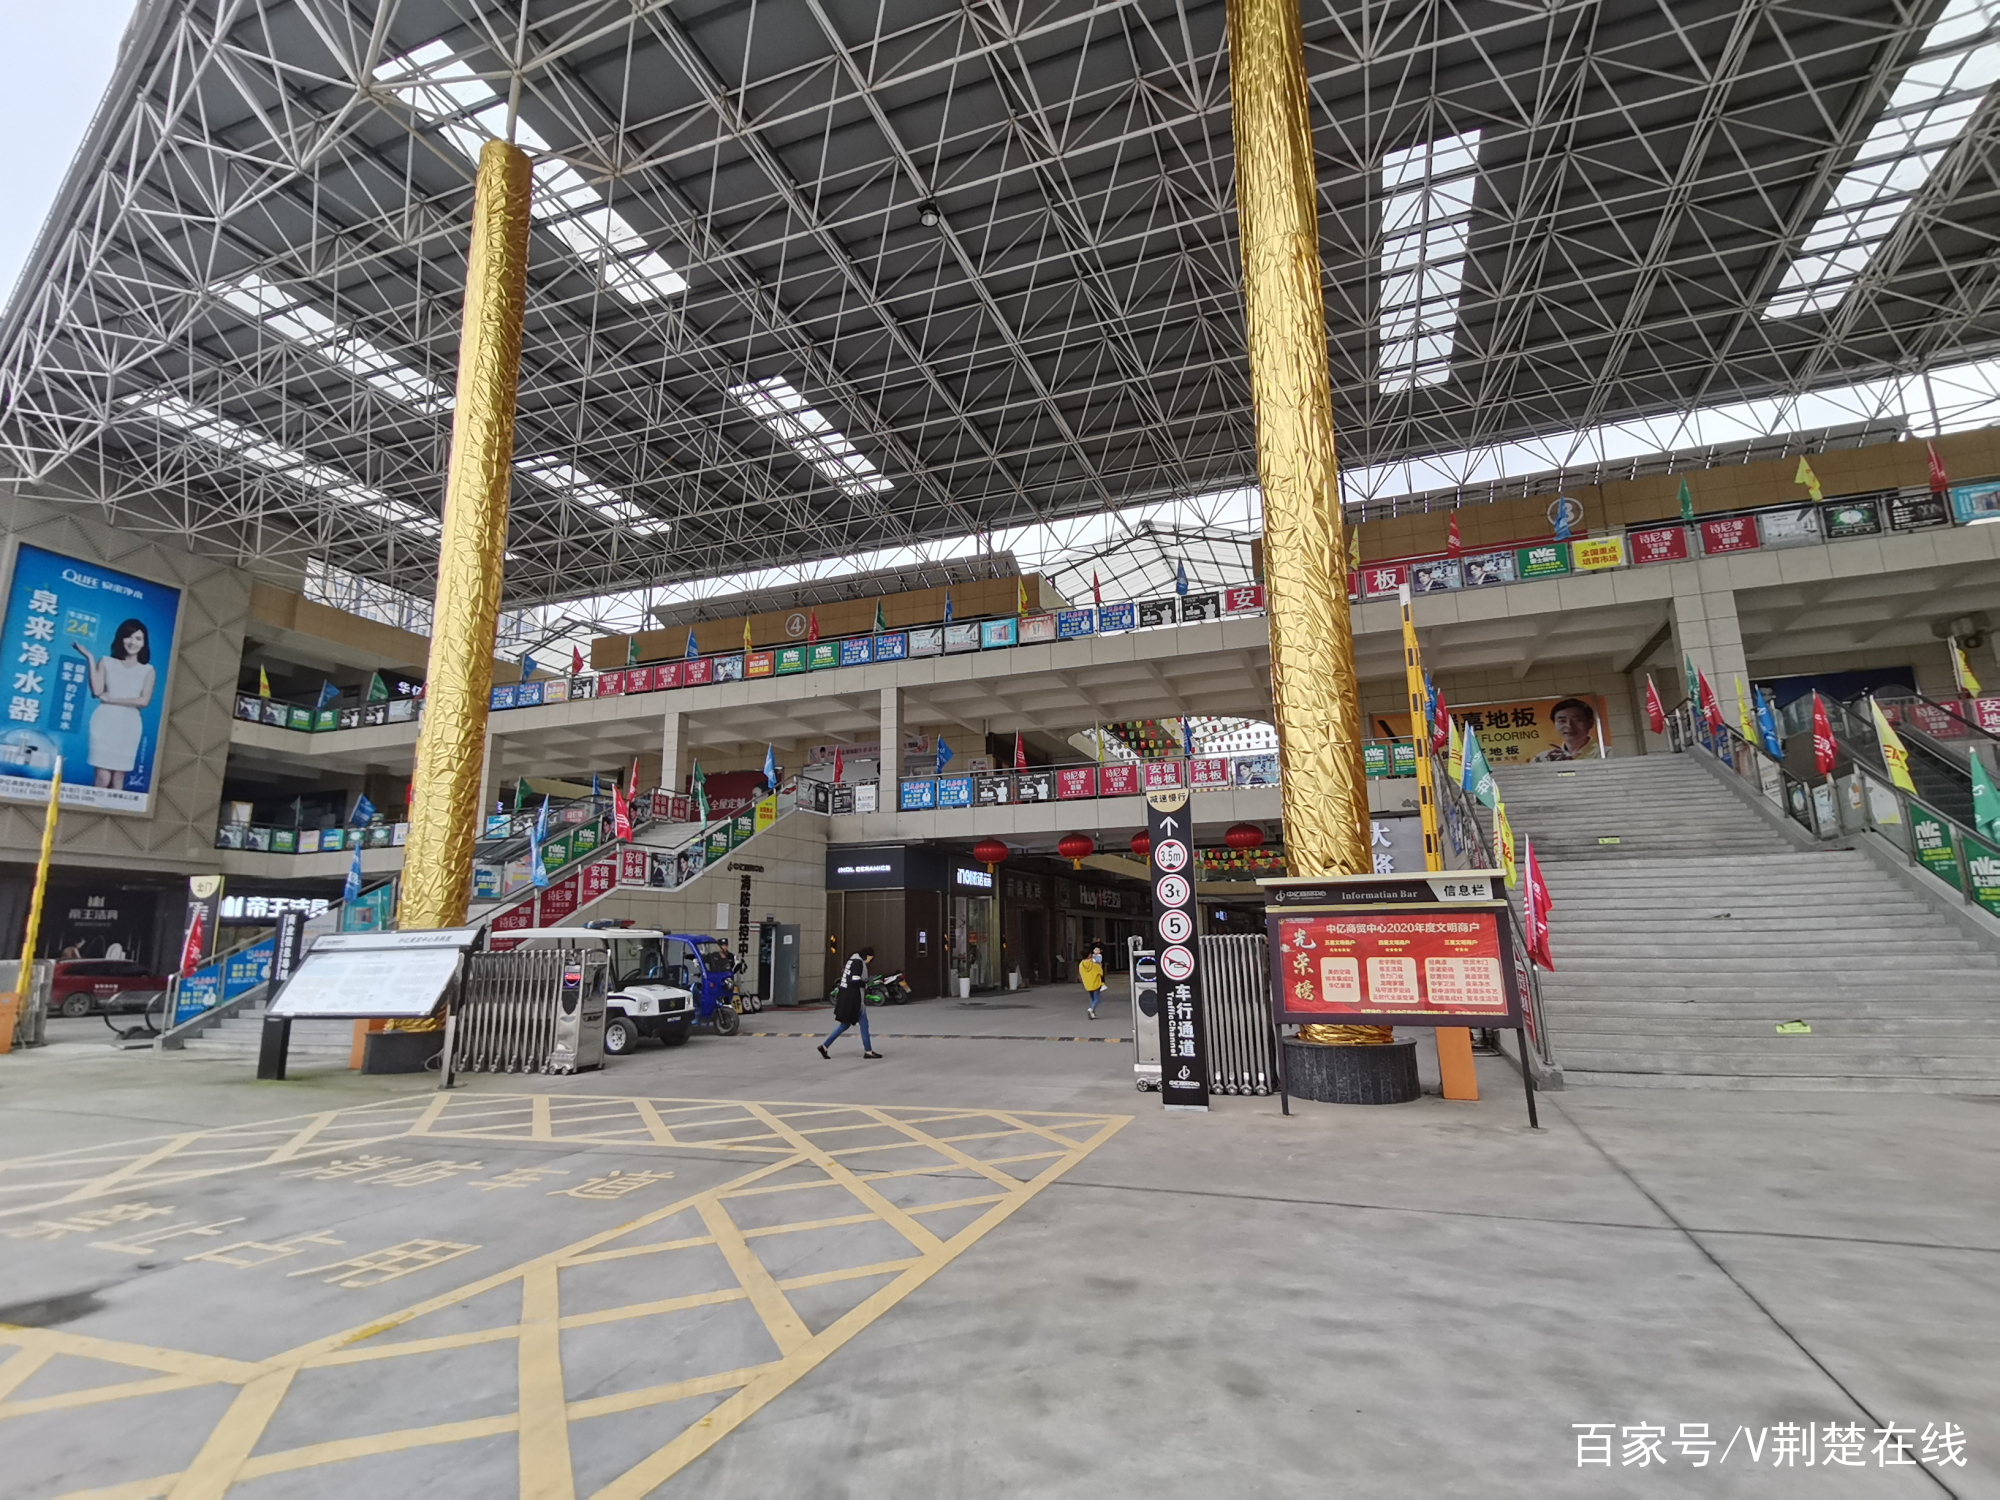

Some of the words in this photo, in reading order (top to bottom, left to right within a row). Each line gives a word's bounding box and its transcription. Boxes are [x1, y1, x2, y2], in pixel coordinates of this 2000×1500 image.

[1563, 502, 1575, 520] 3
[1581, 546, 1617, 557] 全国重点
[1582, 555, 1618, 565] 培育市场
[1374, 569, 1399, 589] 板
[1233, 589, 1255, 609] 安
[790, 620, 801, 632] 4
[8, 589, 58, 723] 泉来净水器
[62, 662, 74, 681] 安全
[1481, 730, 1539, 743] FLOORING
[1149, 763, 1175, 774] 安信
[1194, 759, 1221, 771] 安信
[1149, 774, 1177, 785] 地板
[1194, 769, 1221, 781] 地板
[711, 798, 746, 811] 全屋定制
[1150, 792, 1186, 804] 减速慢行
[1370, 822, 1392, 848] 大
[626, 852, 644, 864] 安信
[1160, 850, 1181, 862] 3.5m
[591, 865, 610, 878] 安信
[624, 865, 643, 878] 地板
[589, 878, 610, 890] 地板
[1165, 883, 1181, 898] 3t
[1443, 884, 1485, 897] 信息栏
[1400, 889, 1418, 898] Bar
[68, 908, 118, 921] 帝王洁具
[1169, 917, 1181, 934] 5
[1325, 922, 1480, 934] 中亿商贸中心2020年度文明商户
[1292, 927, 1317, 1001] 光荣榜
[1175, 983, 1196, 1057] 车行通道
